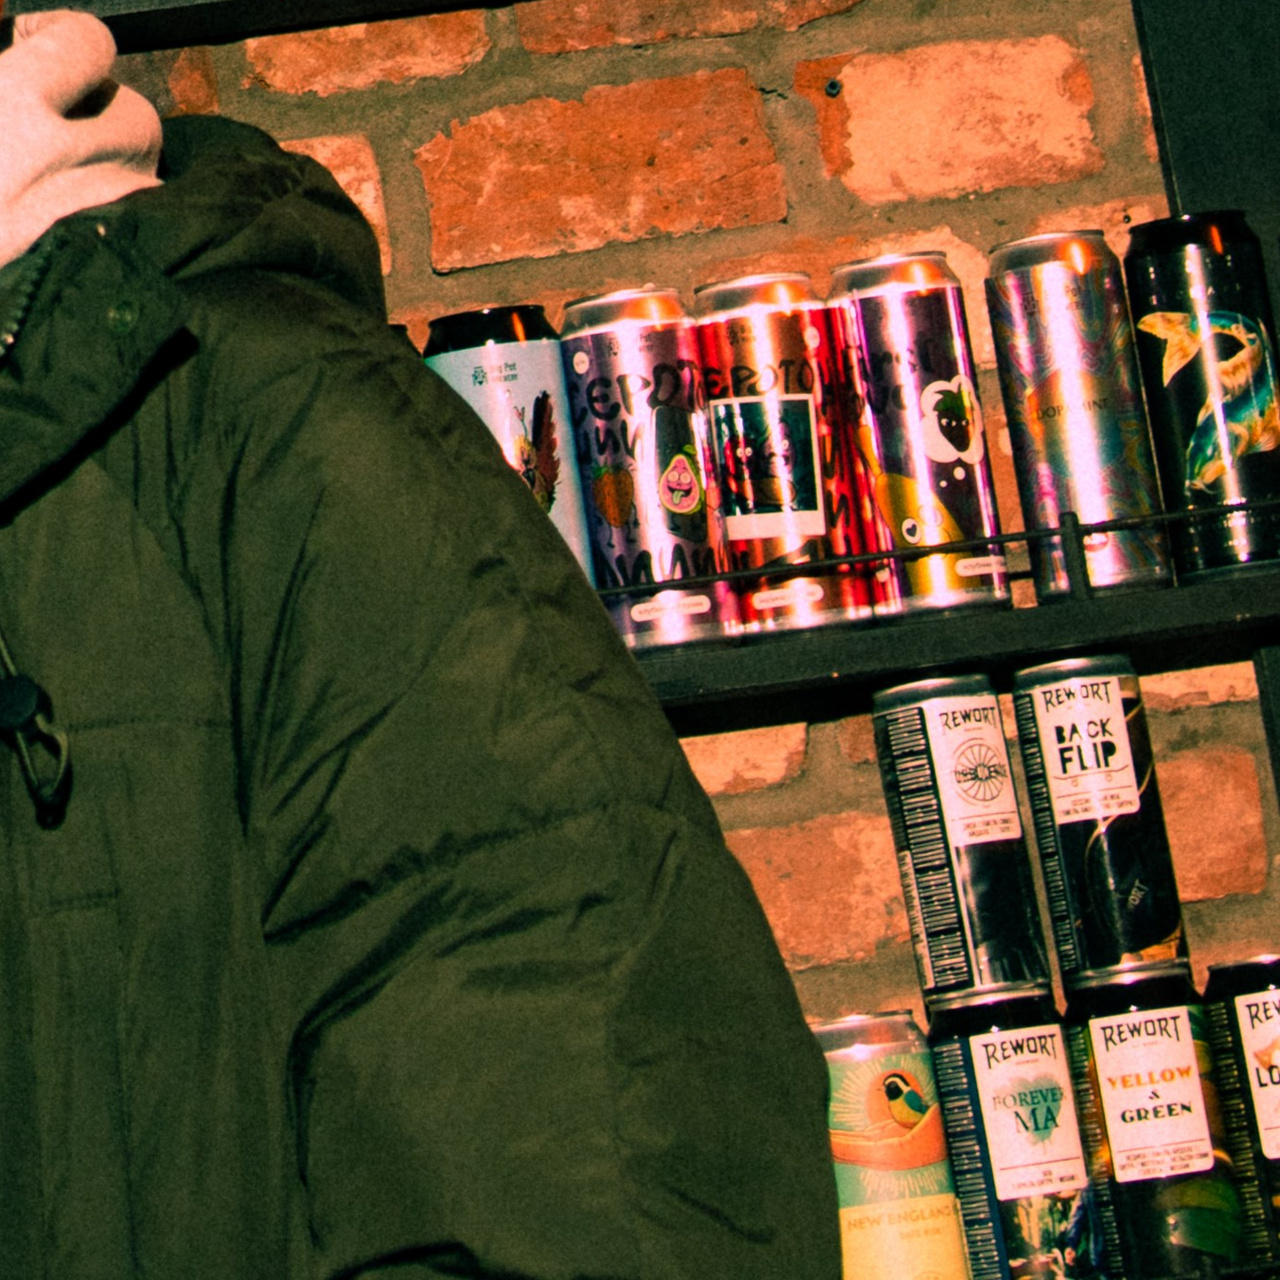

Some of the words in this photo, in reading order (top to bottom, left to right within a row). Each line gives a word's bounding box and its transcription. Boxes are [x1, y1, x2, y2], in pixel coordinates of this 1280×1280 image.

[1042, 681, 1111, 713] REWORT
[939, 706, 998, 731] REWORT
[1054, 717, 1114, 745] BACK
[1058, 740, 1117, 774] FLIP
[1100, 1015, 1181, 1052] REWORT
[982, 1033, 1058, 1070] REWORT
[1107, 1066, 1193, 1090] YELLOW
[992, 1086, 1068, 1111] FOREVER
[1120, 1101, 1193, 1124] GREEN
[1013, 1105, 1061, 1134] MA
[847, 1216, 881, 1230] NEW
[887, 1204, 952, 1225] ENGLAND
